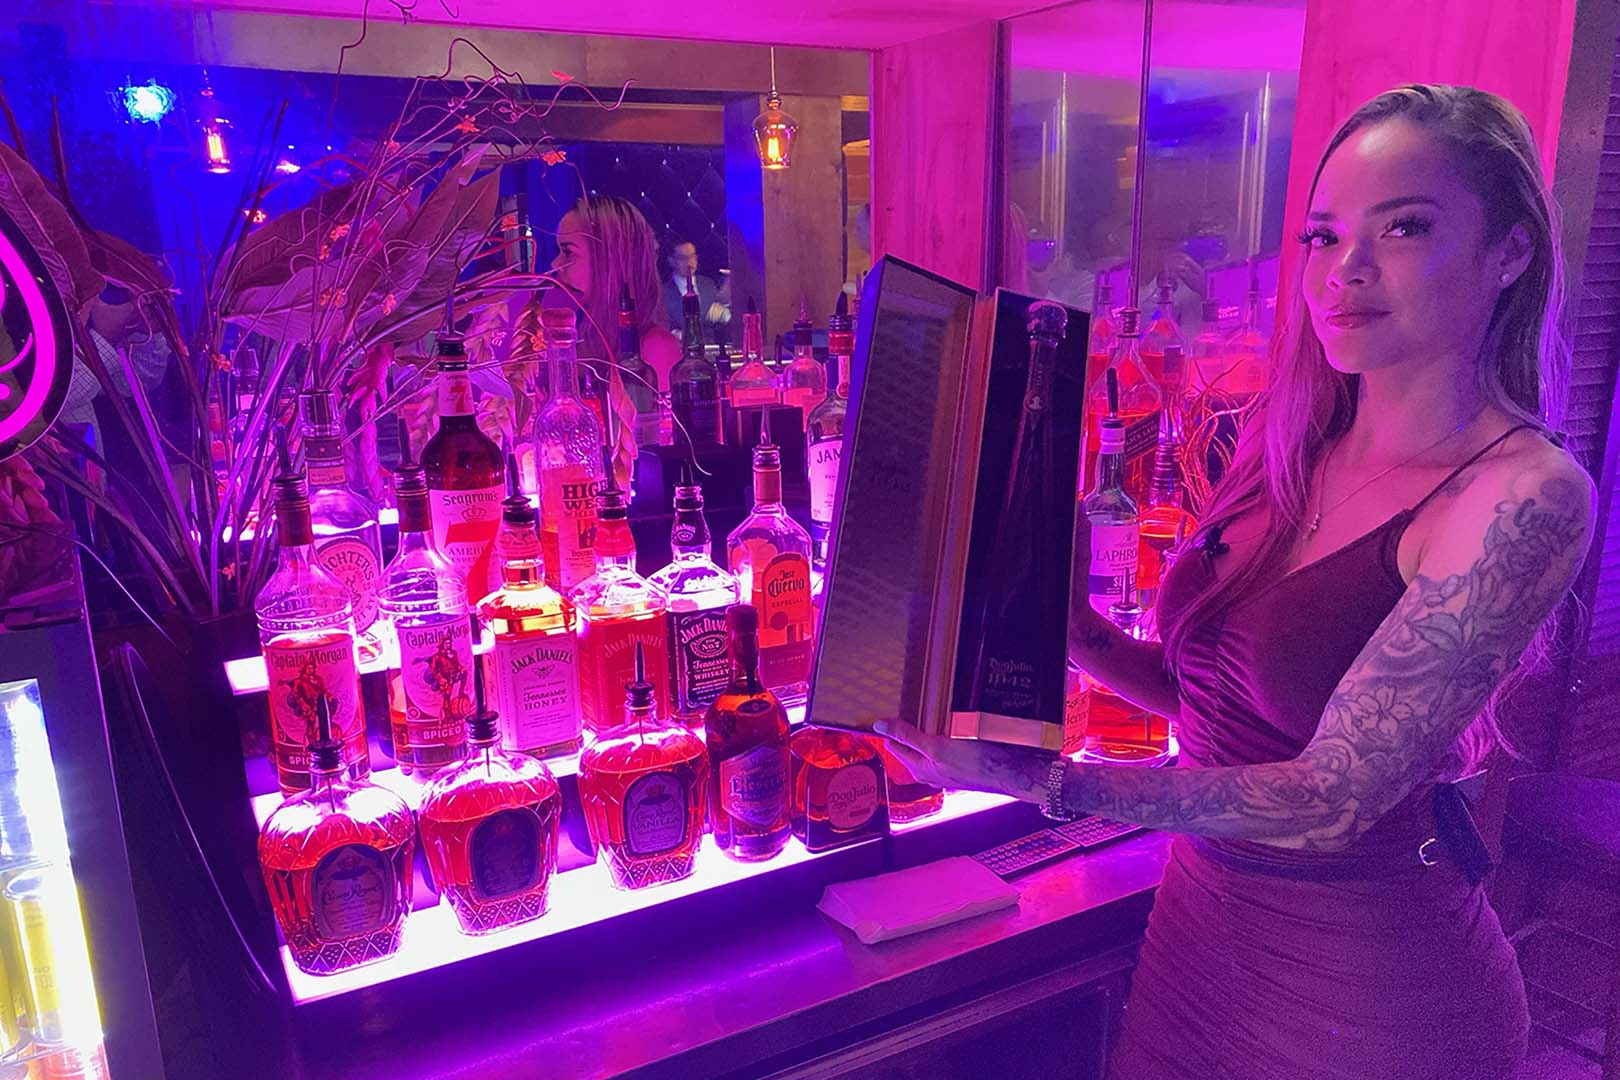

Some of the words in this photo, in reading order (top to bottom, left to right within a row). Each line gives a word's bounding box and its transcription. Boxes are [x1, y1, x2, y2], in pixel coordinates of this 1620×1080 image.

[443, 489, 499, 507] Seagram's
[768, 577, 804, 598] Cuervo
[405, 629, 444, 649] Captain
[680, 623, 705, 644] JACK
[270, 651, 306, 672] Captain
[305, 646, 348, 666] Morgan
[510, 653, 537, 675] JACK
[694, 667, 730, 680] WHISKEY
[523, 688, 567, 703] Tennessee
[524, 695, 568, 711] HONEY
[423, 726, 461, 740] SPICED
[288, 755, 312, 766] SPIC
[632, 814, 681, 832] VANILLA
